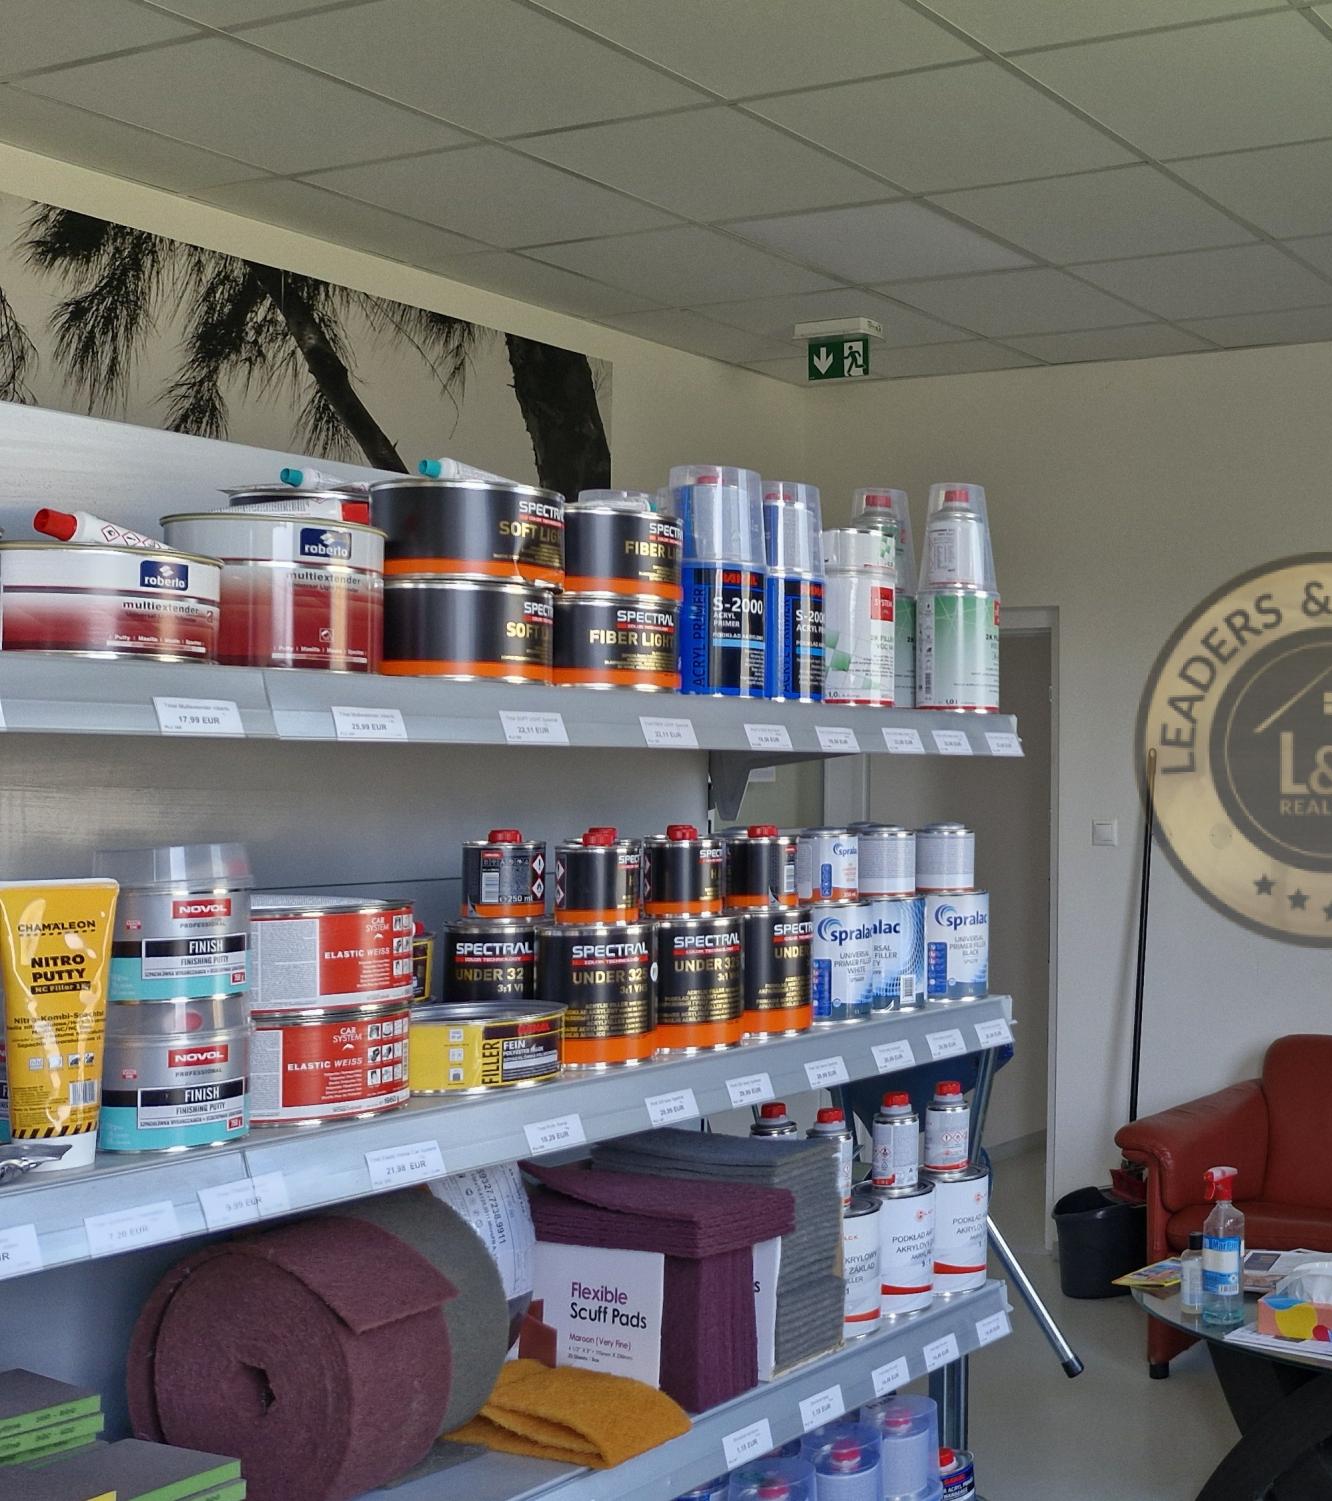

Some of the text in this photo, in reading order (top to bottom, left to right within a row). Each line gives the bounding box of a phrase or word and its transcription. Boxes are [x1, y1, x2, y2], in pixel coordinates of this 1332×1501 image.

[500, 521, 538, 537] SOFT
[305, 542, 347, 557] roberlo
[625, 541, 665, 558] FIBER
[144, 575, 185, 588] roberlo
[287, 572, 361, 586] multiextender
[123, 600, 199, 615] multiextender
[713, 597, 763, 614] S-2000
[616, 610, 674, 626] SPECTRAL
[713, 620, 740, 628] PRIMER
[506, 622, 538, 639] SOFT
[590, 630, 674, 647] FIBER LIGHT
[203, 716, 219, 725] EUR
[372, 723, 387, 731] EUR
[535, 727, 549, 735] EUR
[179, 904, 227, 913] NOVOL
[946, 911, 987, 930] spralac
[189, 940, 223, 954] FINISH
[674, 932, 740, 949] SPECTRAL
[325, 947, 390, 959] ELASTIC WEISS
[456, 942, 533, 955] SPECTRAL
[572, 941, 648, 958] SPECTRAL
[31, 954, 84, 968] NITRO
[181, 956, 229, 966] FINISHING PUTTY
[674, 958, 722, 972] UNDER
[834, 959, 858, 968] PRIMER
[32, 968, 87, 983] PUTTY
[456, 968, 524, 981] UNDER 32
[847, 966, 866, 974] WHITE
[573, 970, 625, 985] UNDER
[498, 983, 511, 992] 3:1
[340, 1027, 356, 1035] CAR
[332, 1033, 362, 1043] SYSTEM
[503, 1040, 525, 1050] FEIN
[175, 1051, 224, 1062] NOVOL
[482, 1041, 500, 1085] FILLER
[287, 1057, 362, 1071] ELASTIC WEISS
[175, 1069, 222, 1077] PROFESSIONAL
[185, 1086, 220, 1102] FINISH
[176, 1103, 225, 1115] FINISHING PUTTY
[557, 1131, 569, 1140] EUR
[410, 1160, 426, 1170] EUR
[892, 1232, 926, 1243] PODKŁAD
[845, 1252, 877, 1263] KRYLOWY
[849, 1262, 875, 1275] ZÁKLAD
[572, 1282, 628, 1305] Flexible
[570, 1302, 647, 1329] Scuff Pads
[569, 1333, 631, 1351] Maroon (Very Fine)
